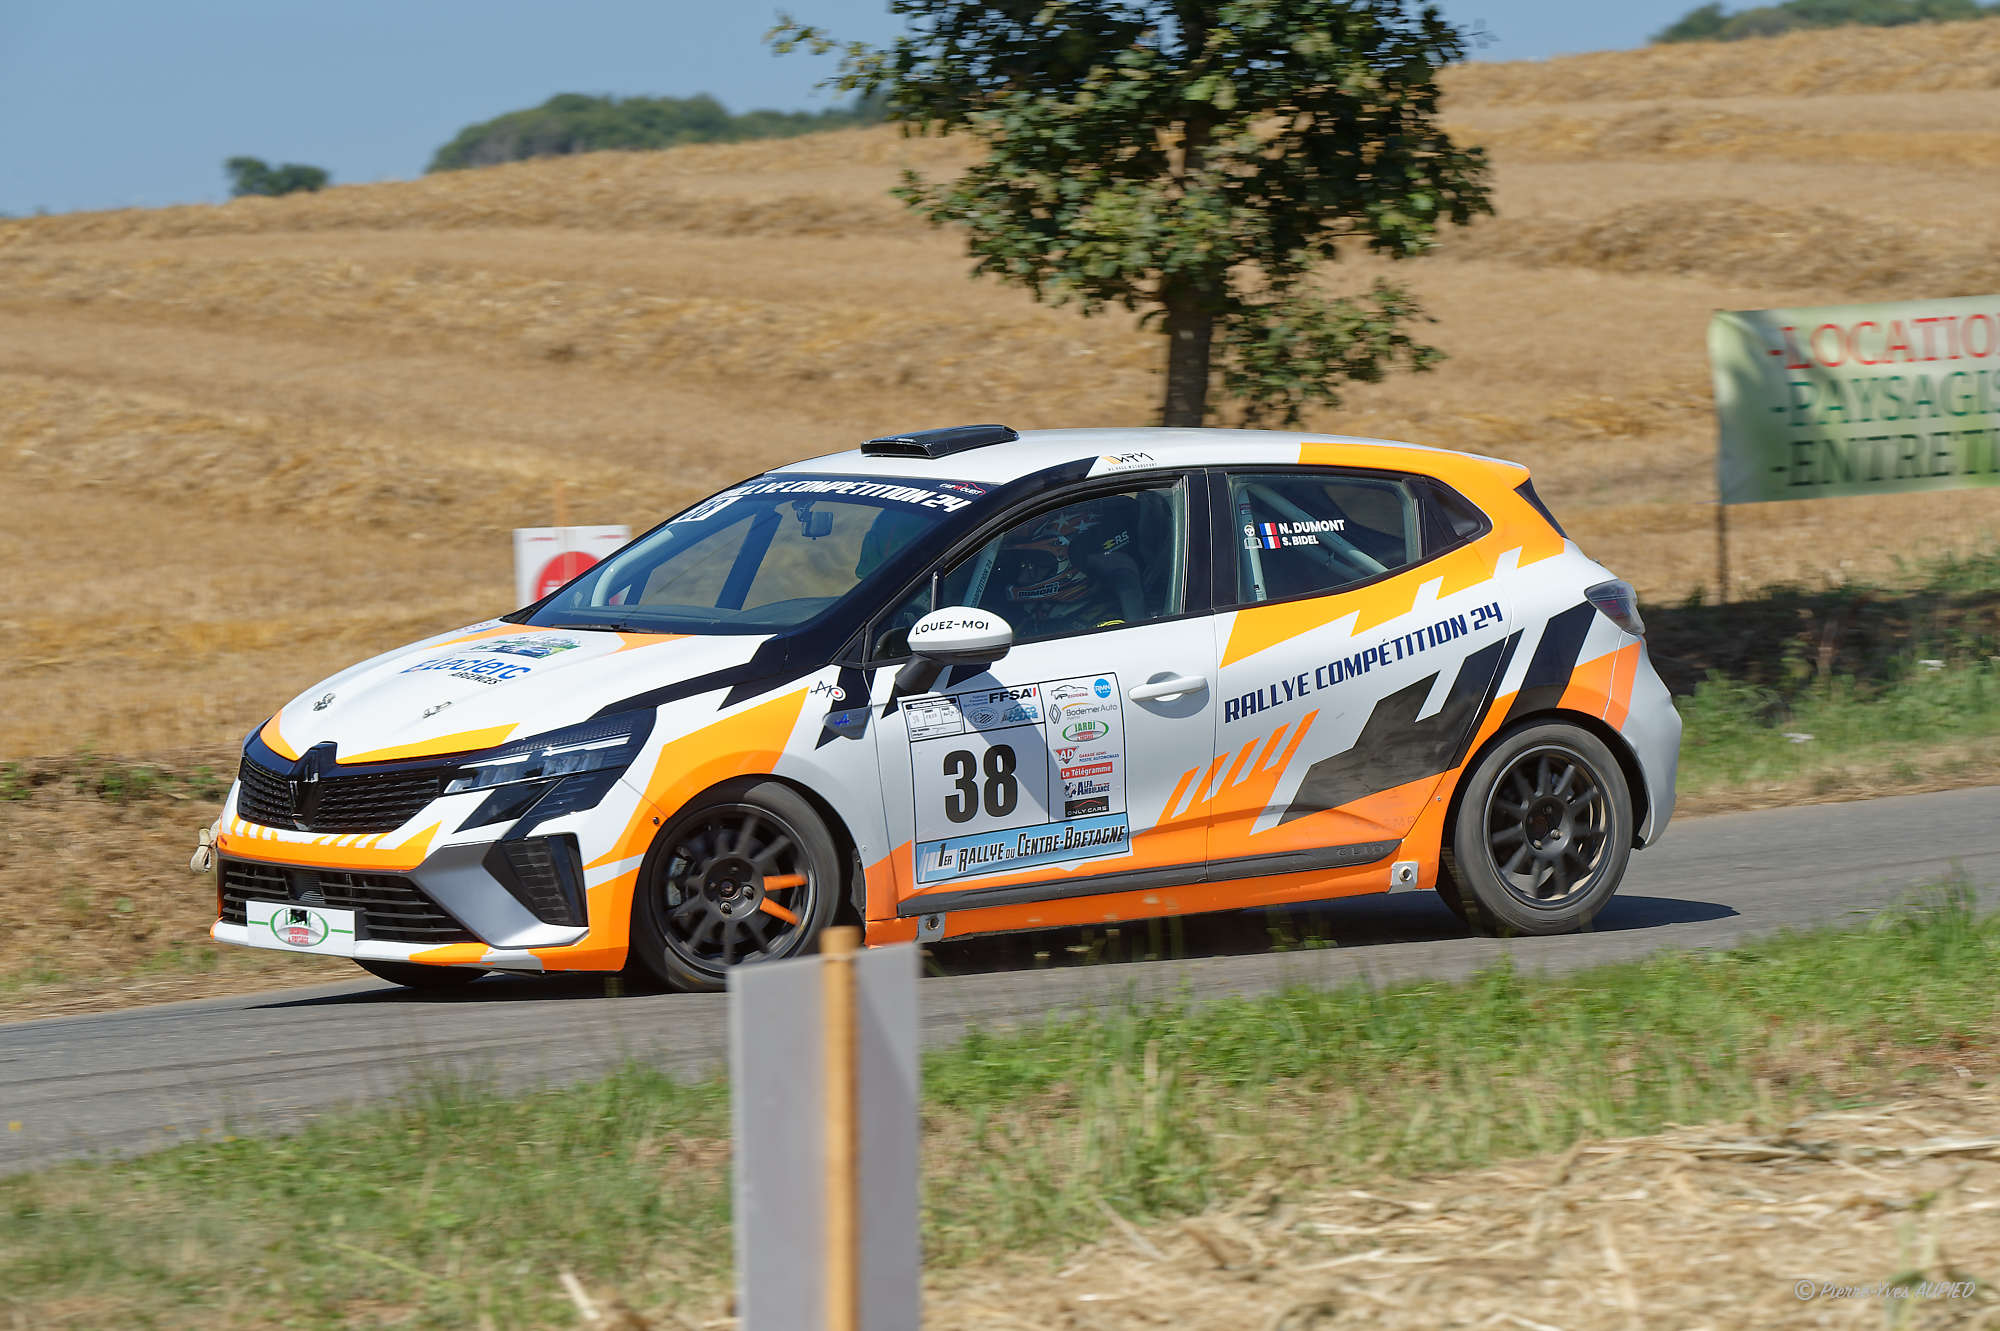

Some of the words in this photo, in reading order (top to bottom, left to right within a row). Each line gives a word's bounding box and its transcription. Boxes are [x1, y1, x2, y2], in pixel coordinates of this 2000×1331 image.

[1767, 313, 2000, 370] -LOCATIO
[920, 495, 972, 513] 24
[1278, 523, 1293, 534] N.
[1294, 519, 1345, 533] DUMONT
[1282, 537, 1291, 546] S.
[1293, 534, 1319, 546] BIDEL
[915, 620, 989, 635] LOUEZ-MOI
[1224, 672, 1309, 724] RALLYE
[1315, 613, 1468, 690] COMPÉTITION
[1470, 602, 1503, 631] 24
[989, 688, 1032, 704] FFSA
[1060, 749, 1075, 761] AD
[1062, 770, 1070, 778] Le
[1071, 765, 1112, 776] Télégramme
[943, 744, 1018, 824] 38
[958, 842, 1005, 872] RALLYE
